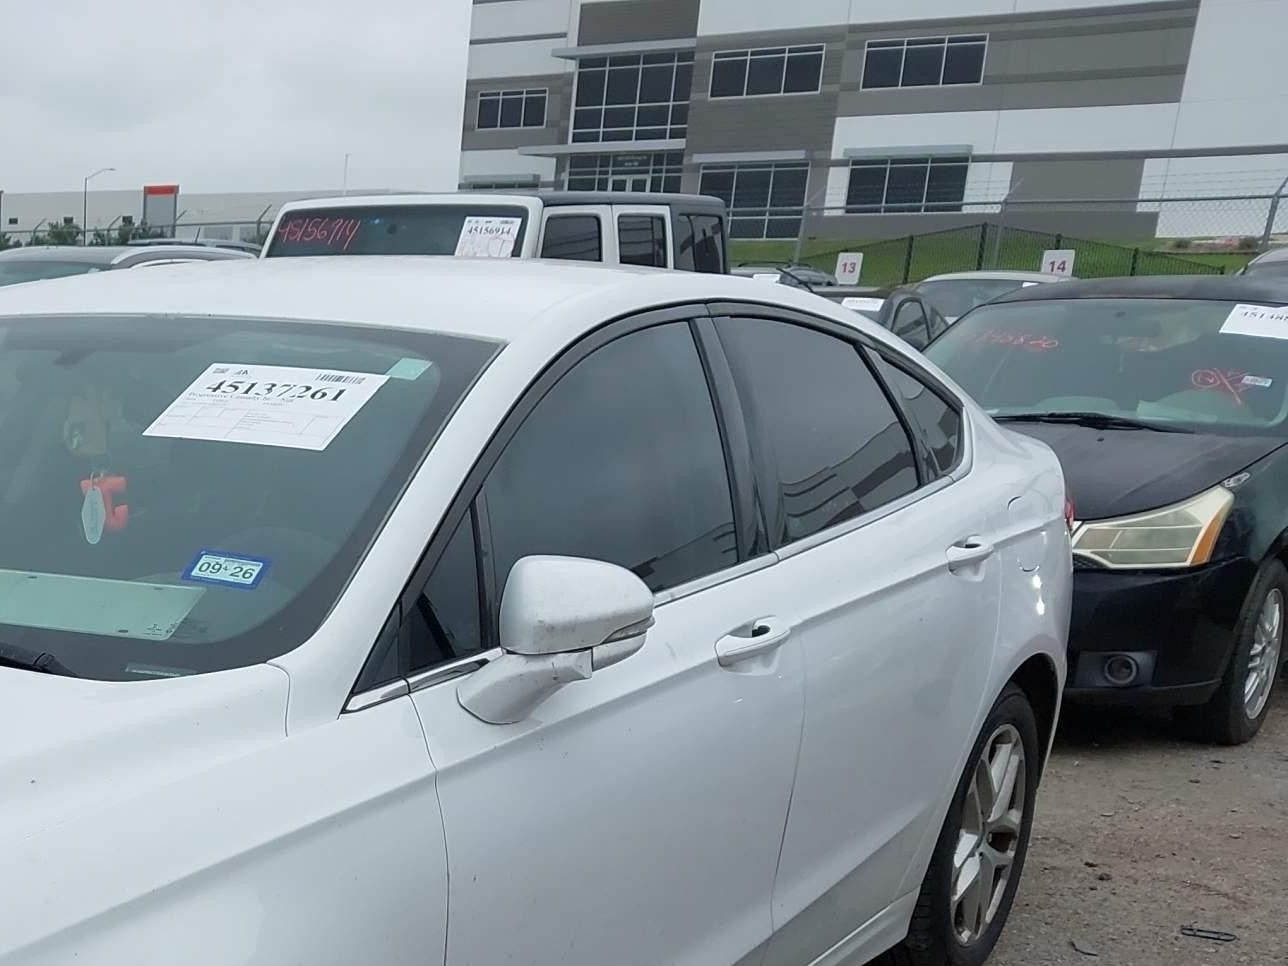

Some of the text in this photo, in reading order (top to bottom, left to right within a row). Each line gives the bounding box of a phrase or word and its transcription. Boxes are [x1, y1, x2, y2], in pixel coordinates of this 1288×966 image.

[842, 262, 857, 273] 13
[1049, 260, 1066, 273] 14
[206, 379, 347, 402] 45137261
[198, 561, 223, 574] 09
[229, 566, 255, 580] 26
